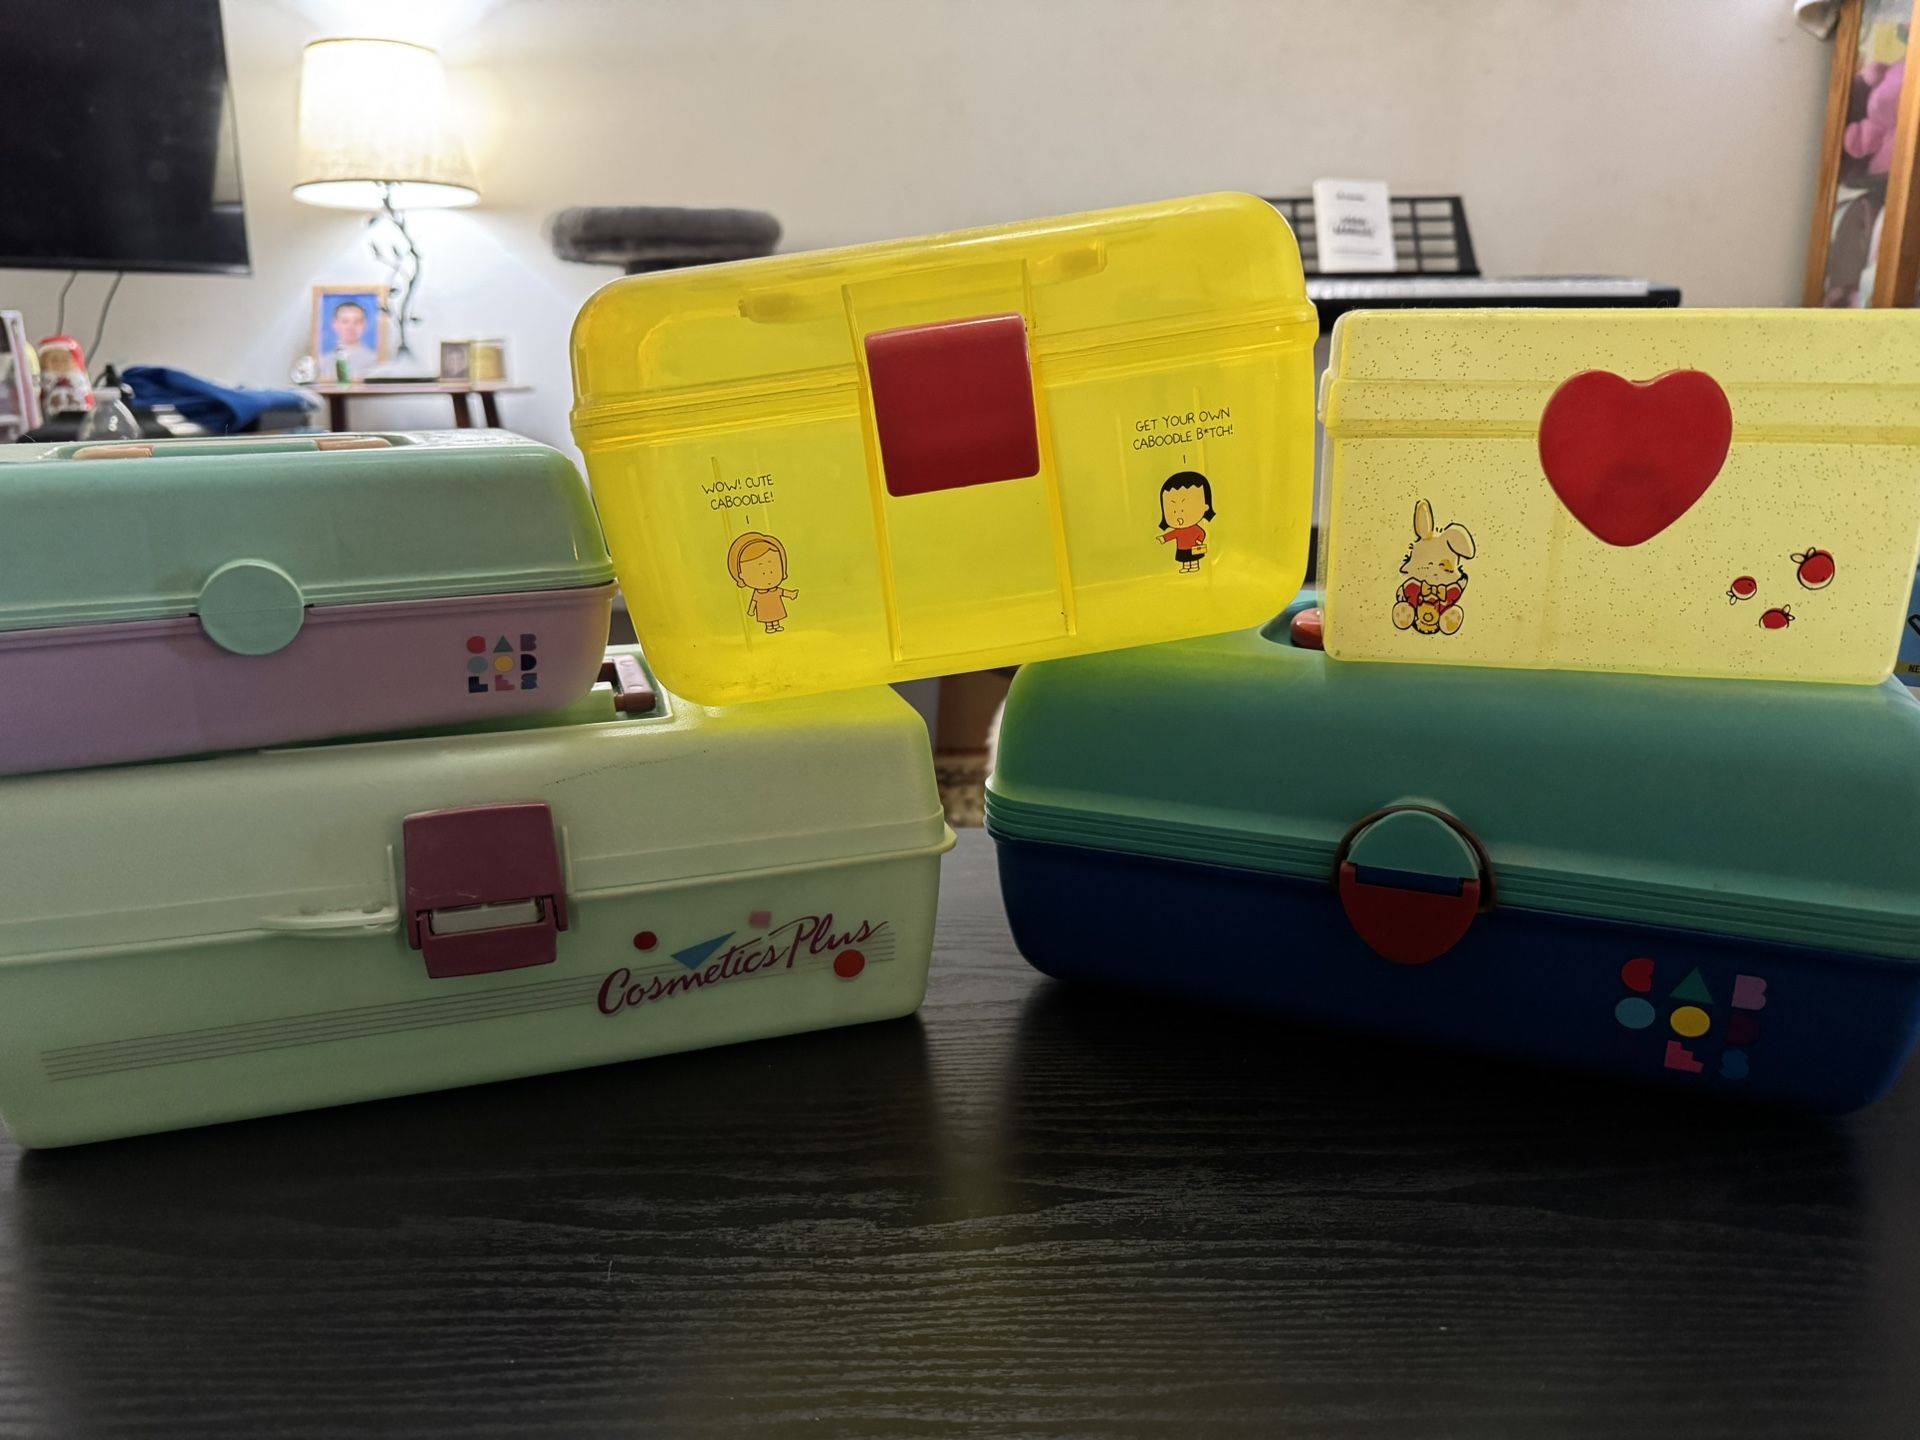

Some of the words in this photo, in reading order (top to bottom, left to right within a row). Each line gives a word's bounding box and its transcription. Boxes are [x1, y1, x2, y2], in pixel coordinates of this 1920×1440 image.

[1135, 419, 1158, 432] GET
[1162, 412, 1195, 428] YOUR
[1198, 407, 1230, 422] OWN
[1132, 431, 1193, 451] CABOODLE
[701, 478, 742, 495] WOW!
[745, 473, 774, 489] CUTE
[710, 491, 775, 511] CABOODLE!
[597, 937, 789, 1015] Cosmetics
[768, 913, 889, 968] Plus
